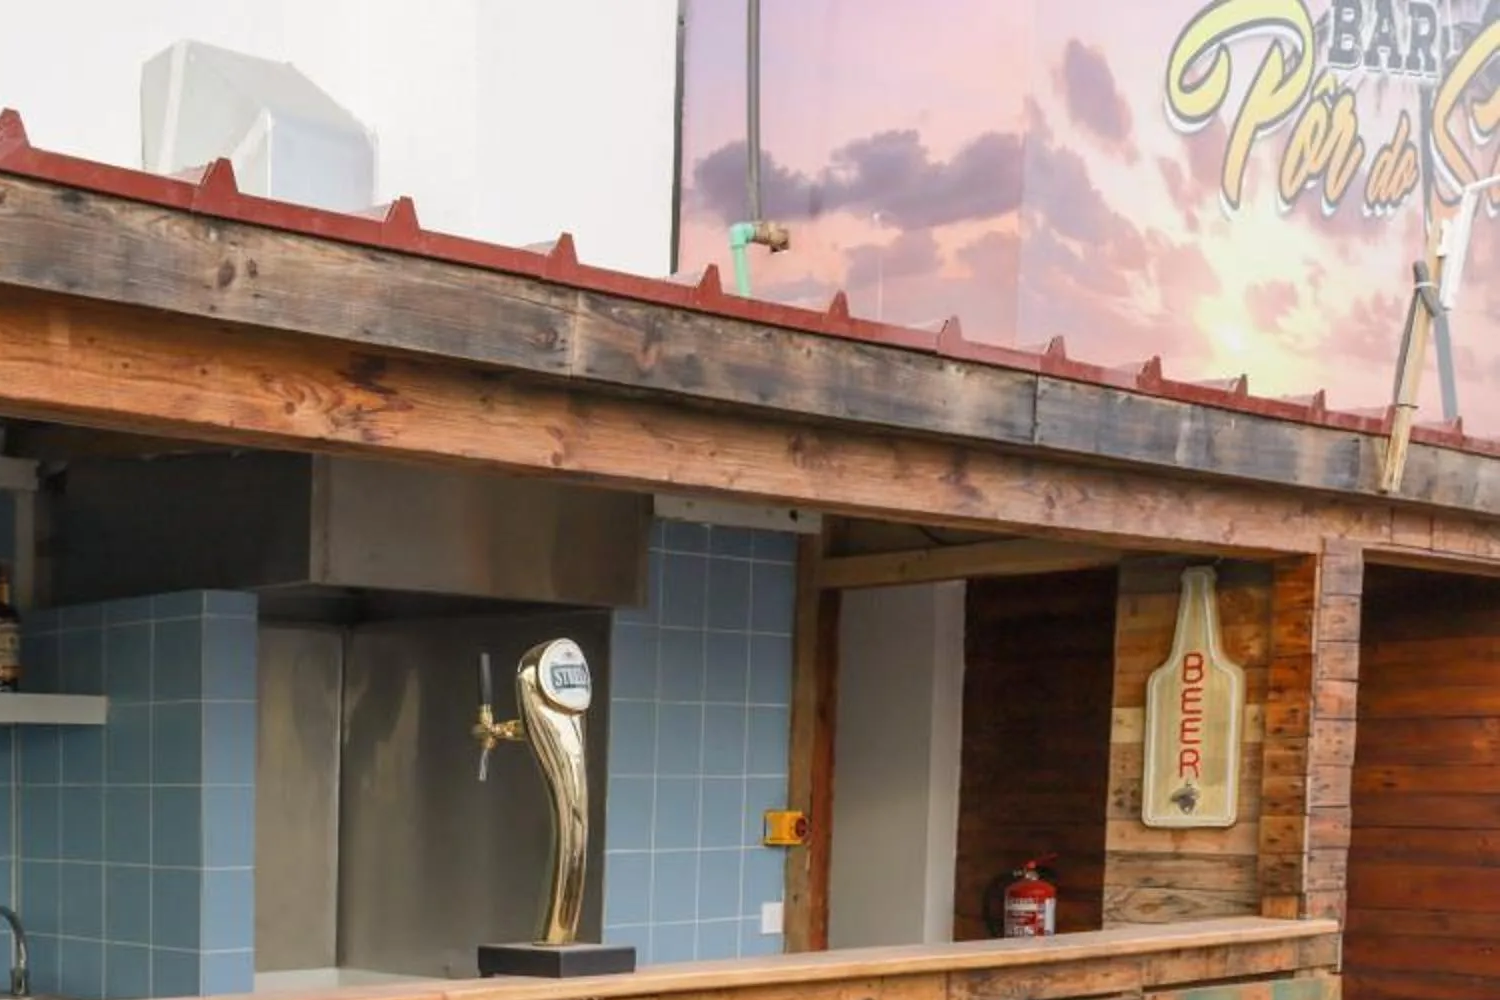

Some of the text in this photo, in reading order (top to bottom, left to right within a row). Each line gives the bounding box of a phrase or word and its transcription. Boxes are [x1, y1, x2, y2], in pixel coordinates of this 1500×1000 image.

[1327, 0, 1439, 75] BAR
[1364, 108, 1420, 210] do
[1179, 653, 1204, 778] BEER
